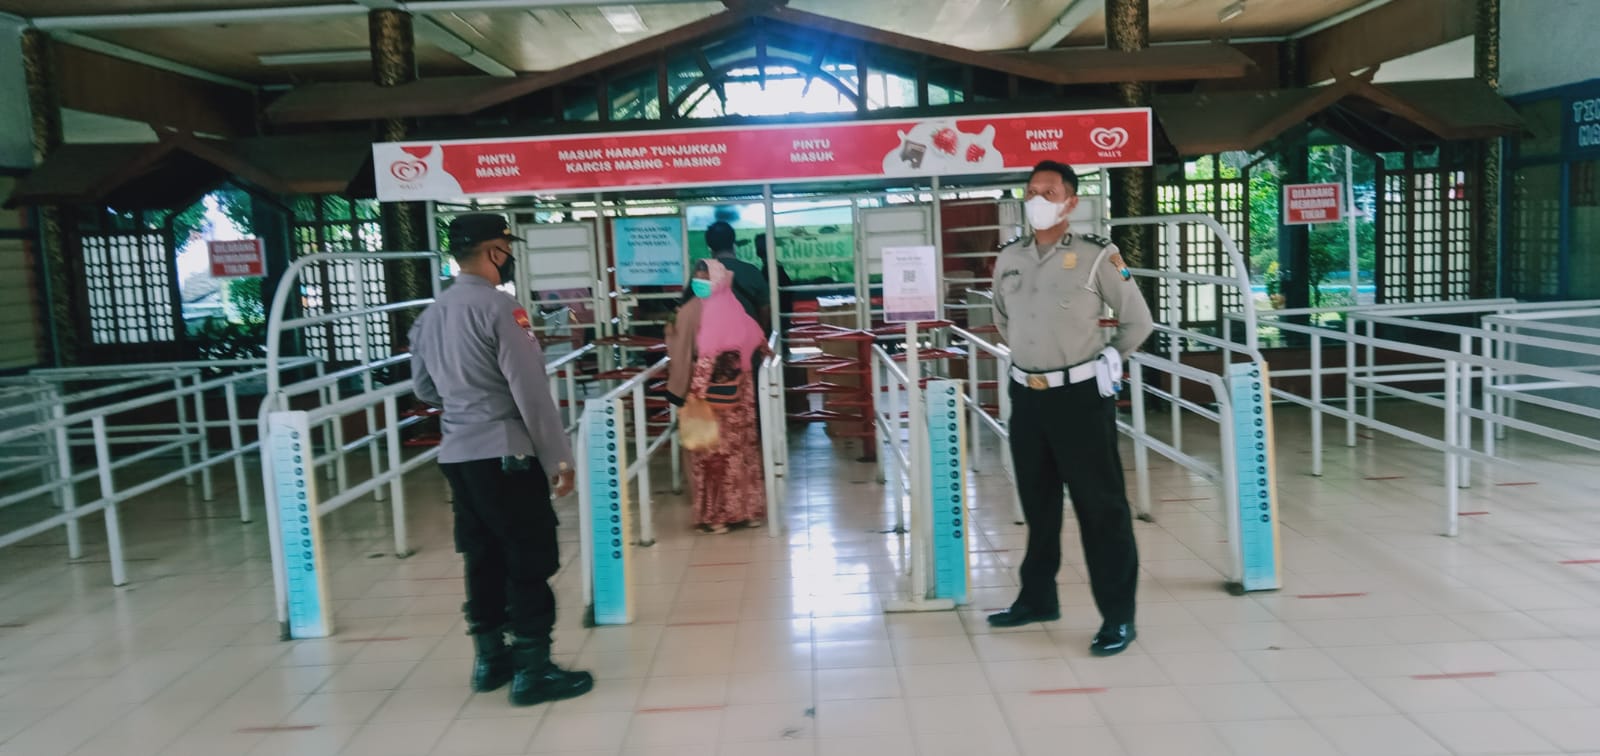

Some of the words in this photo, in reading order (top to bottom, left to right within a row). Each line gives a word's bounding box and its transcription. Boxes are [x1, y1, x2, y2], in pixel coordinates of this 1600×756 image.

[1025, 129, 1064, 140] PINTU
[792, 139, 831, 150] PINTU
[1030, 141, 1059, 152] MASUK
[558, 150, 604, 162] MASUK
[605, 147, 648, 159] HARAP
[649, 143, 728, 157] TUNJUKKAN
[790, 151, 835, 163] MASUK
[477, 153, 516, 166] PINTU
[565, 161, 612, 174] KARCIS
[614, 159, 663, 171] MASING
[672, 156, 722, 168] MASING
[475, 165, 521, 178] MASUK
[1291, 187, 1335, 199] DILARANG
